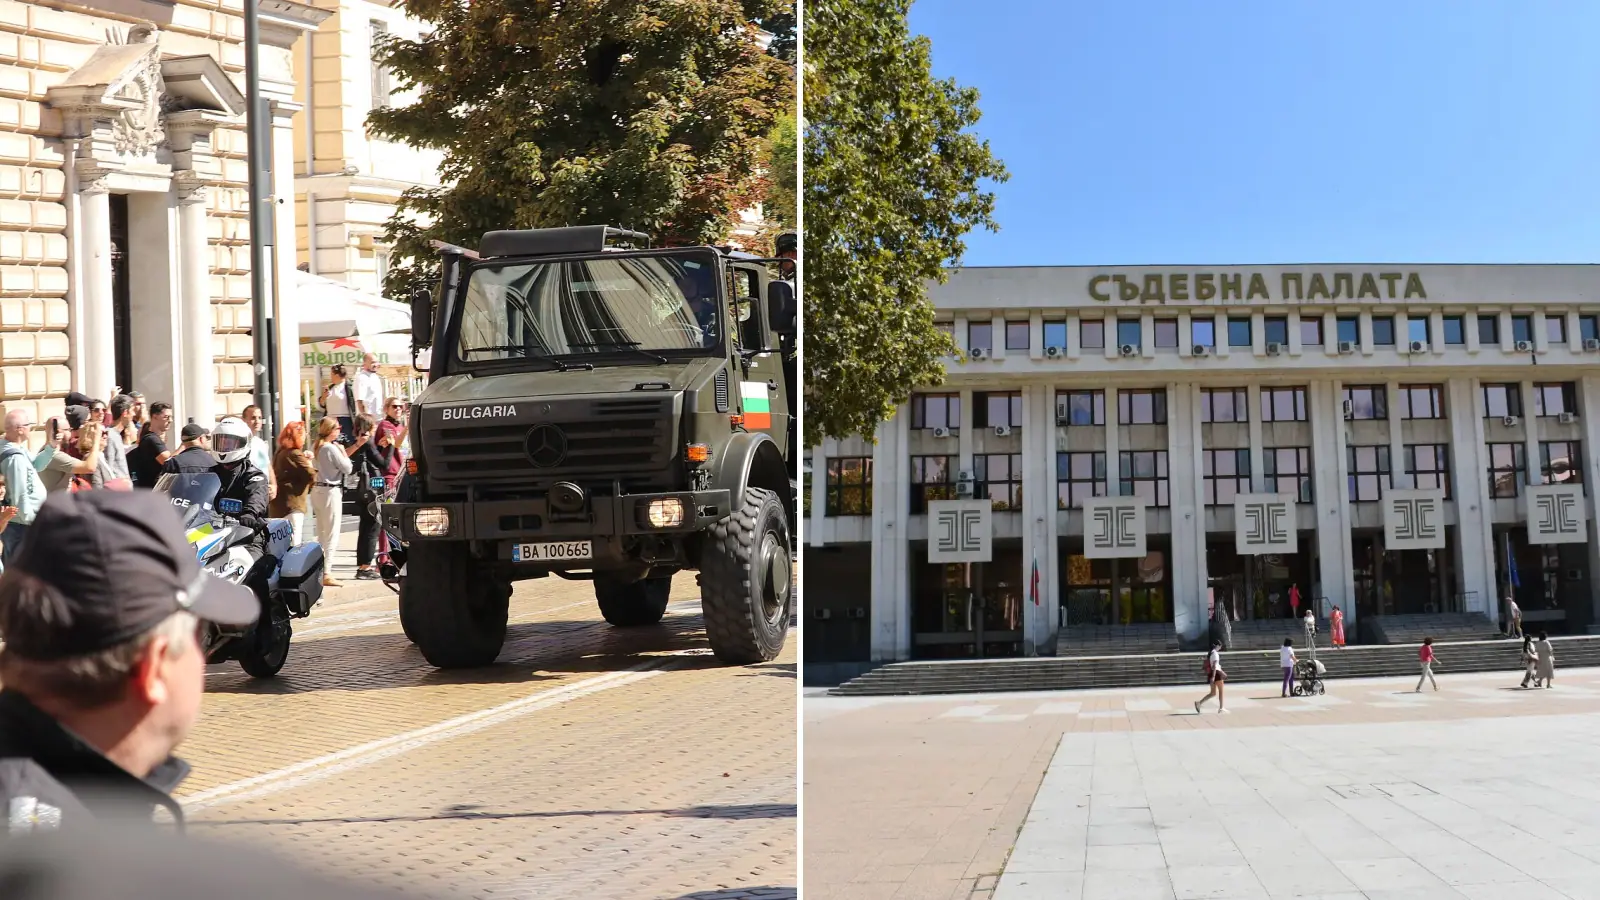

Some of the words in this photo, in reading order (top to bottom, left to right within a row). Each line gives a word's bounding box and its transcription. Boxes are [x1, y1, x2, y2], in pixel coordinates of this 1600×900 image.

[1088, 273, 1270, 304] СЪДЕБНА
[1281, 272, 1427, 299] ПАЛАТА
[303, 350, 389, 366] Heinekn
[442, 404, 517, 420] BULGARIA
[543, 543, 590, 558] 100665
